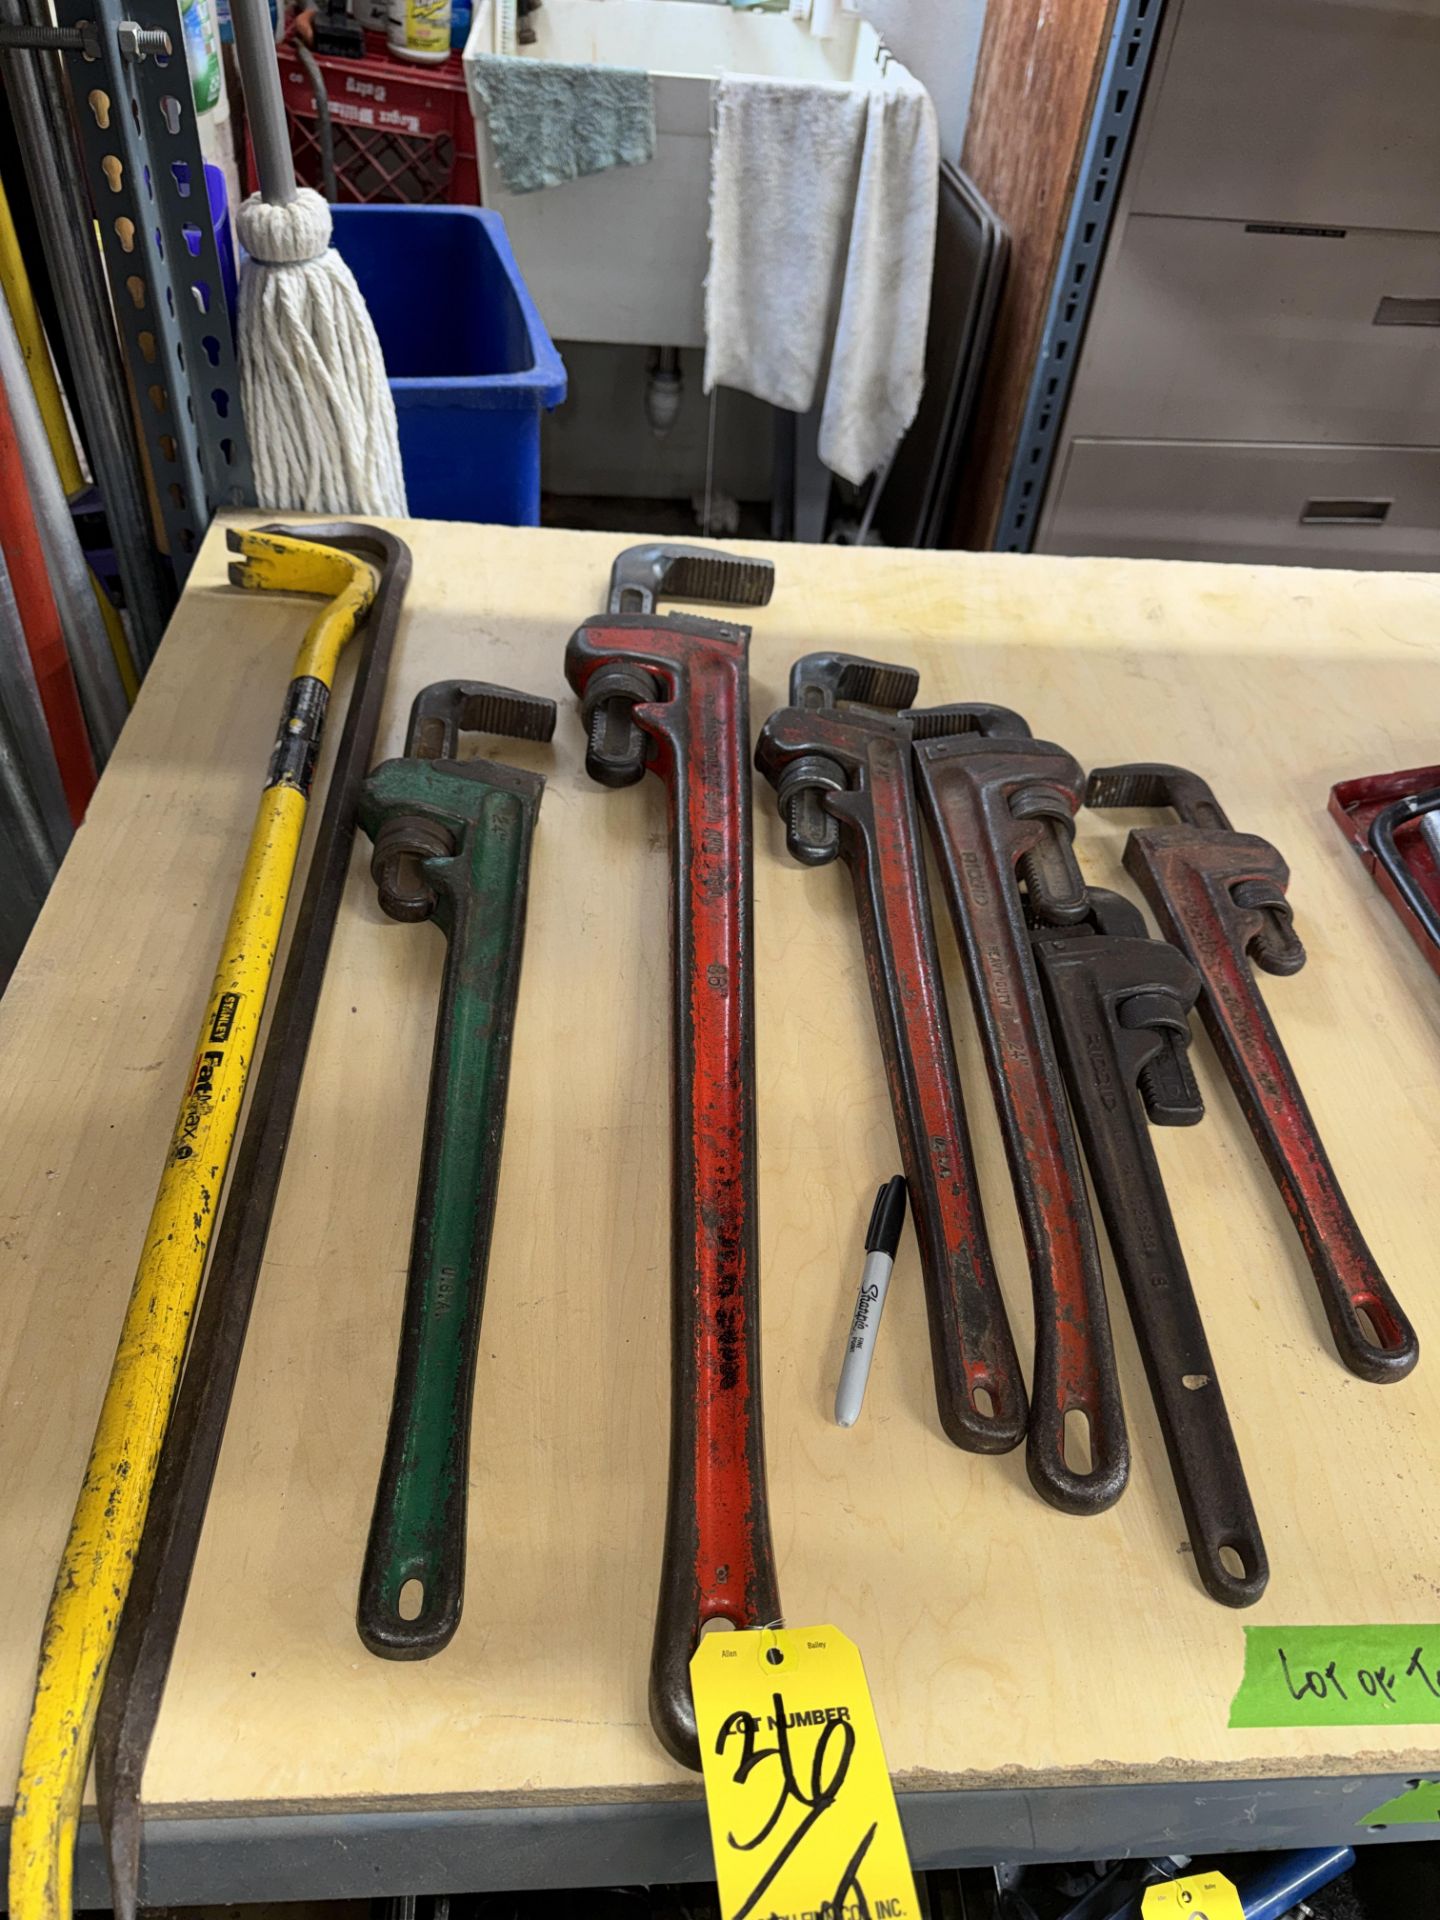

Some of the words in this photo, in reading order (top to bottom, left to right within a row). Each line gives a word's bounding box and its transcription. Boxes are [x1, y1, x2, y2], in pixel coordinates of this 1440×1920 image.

[213, 994, 239, 1041] STANLEY
[852, 1283, 879, 1331] Sharpie
[721, 1649, 738, 1658] Allen
[806, 1640, 827, 1650] Bailey
[768, 1706, 851, 1731] NUMBER
[875, 1898, 908, 1920] INC.
